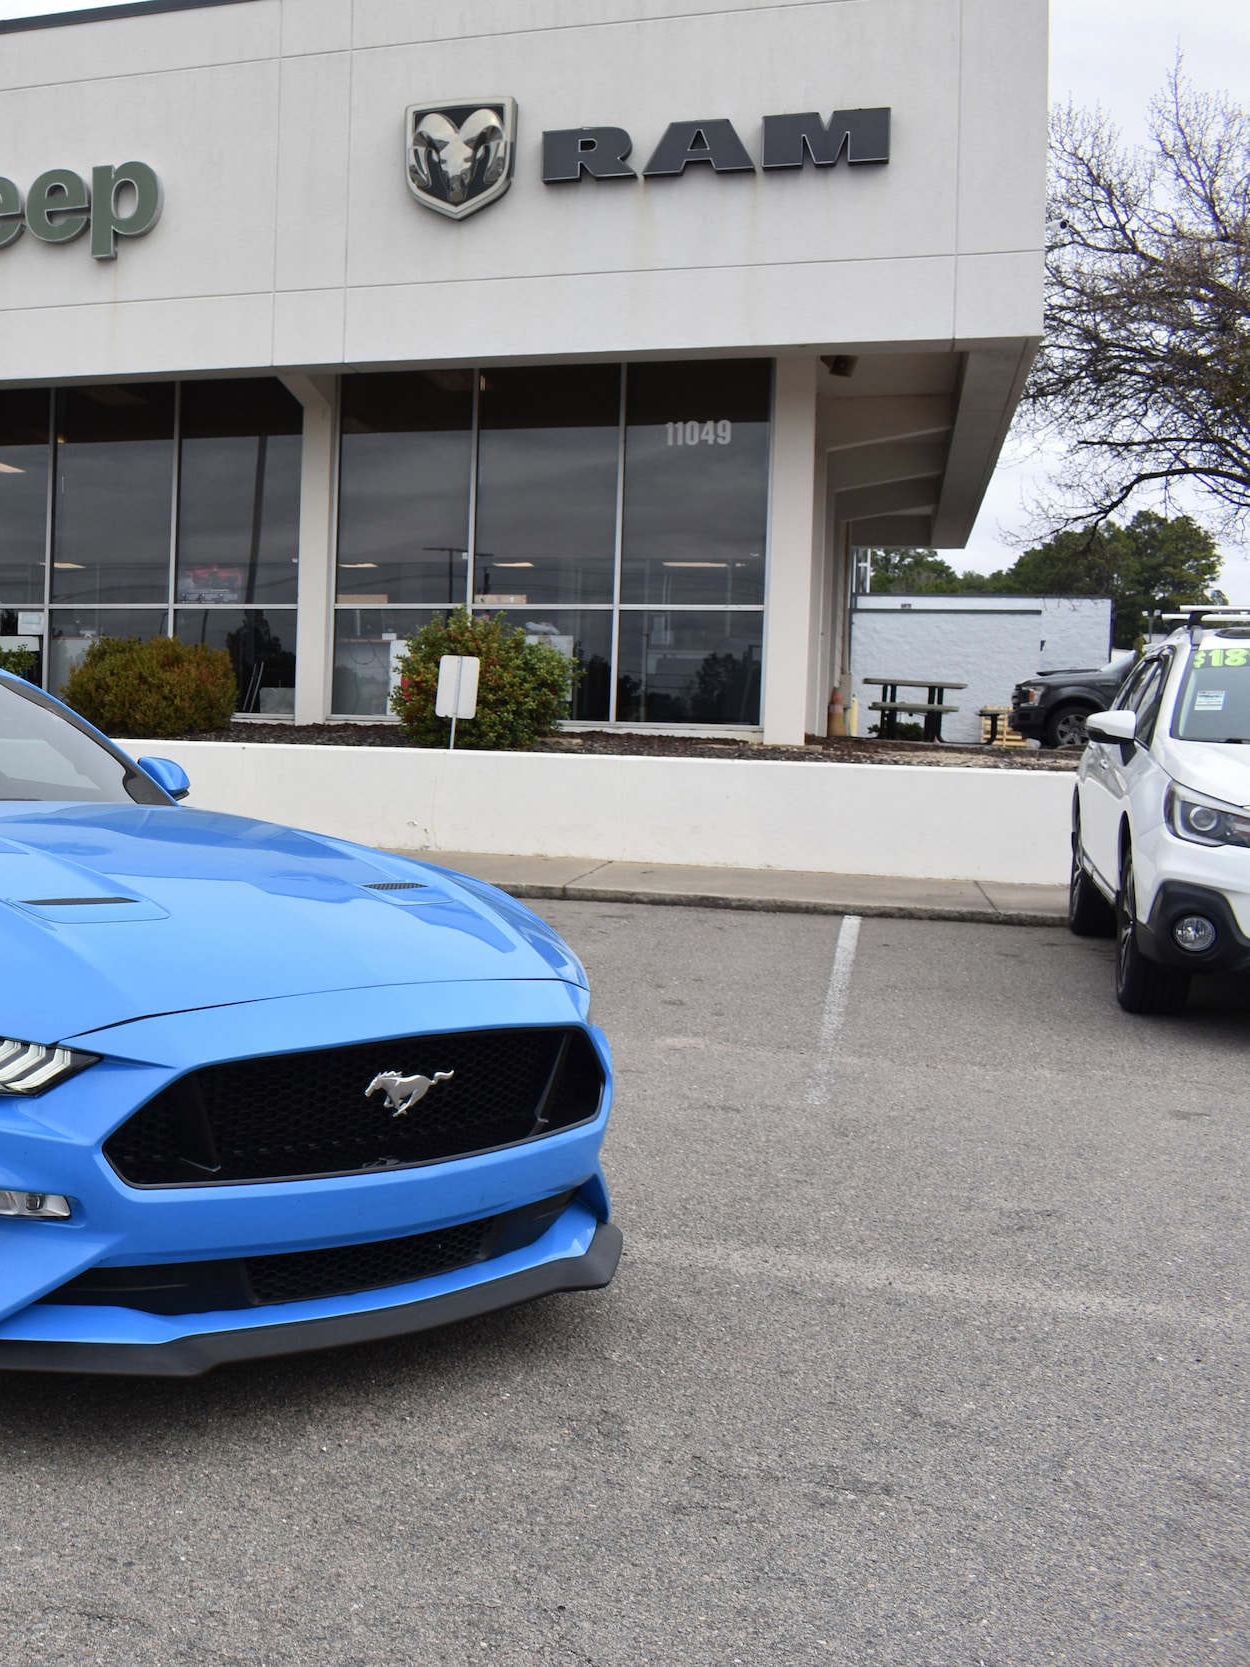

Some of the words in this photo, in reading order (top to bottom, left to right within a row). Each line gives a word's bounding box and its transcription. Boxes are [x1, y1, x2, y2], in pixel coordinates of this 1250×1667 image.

[542, 107, 891, 184] RAM
[665, 419, 732, 446] 11049
[1193, 648, 1250, 669] $18
